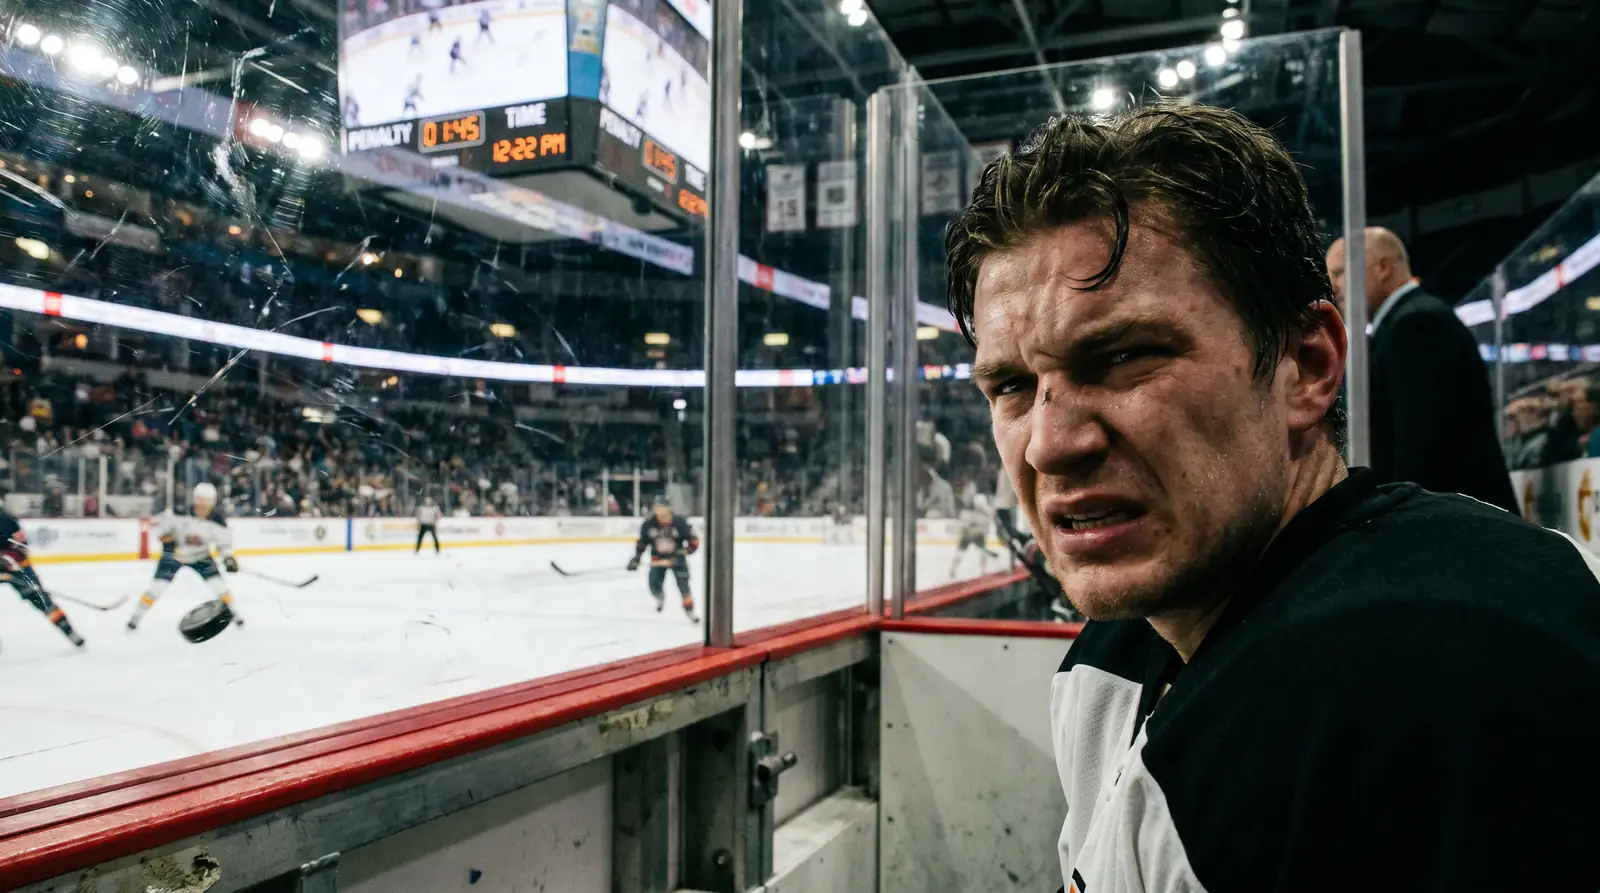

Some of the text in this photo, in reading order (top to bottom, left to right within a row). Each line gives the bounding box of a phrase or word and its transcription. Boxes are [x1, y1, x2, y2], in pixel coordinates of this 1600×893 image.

[505, 102, 547, 128] TIME
[348, 122, 413, 151] PENALTY
[540, 132, 566, 156] PM
